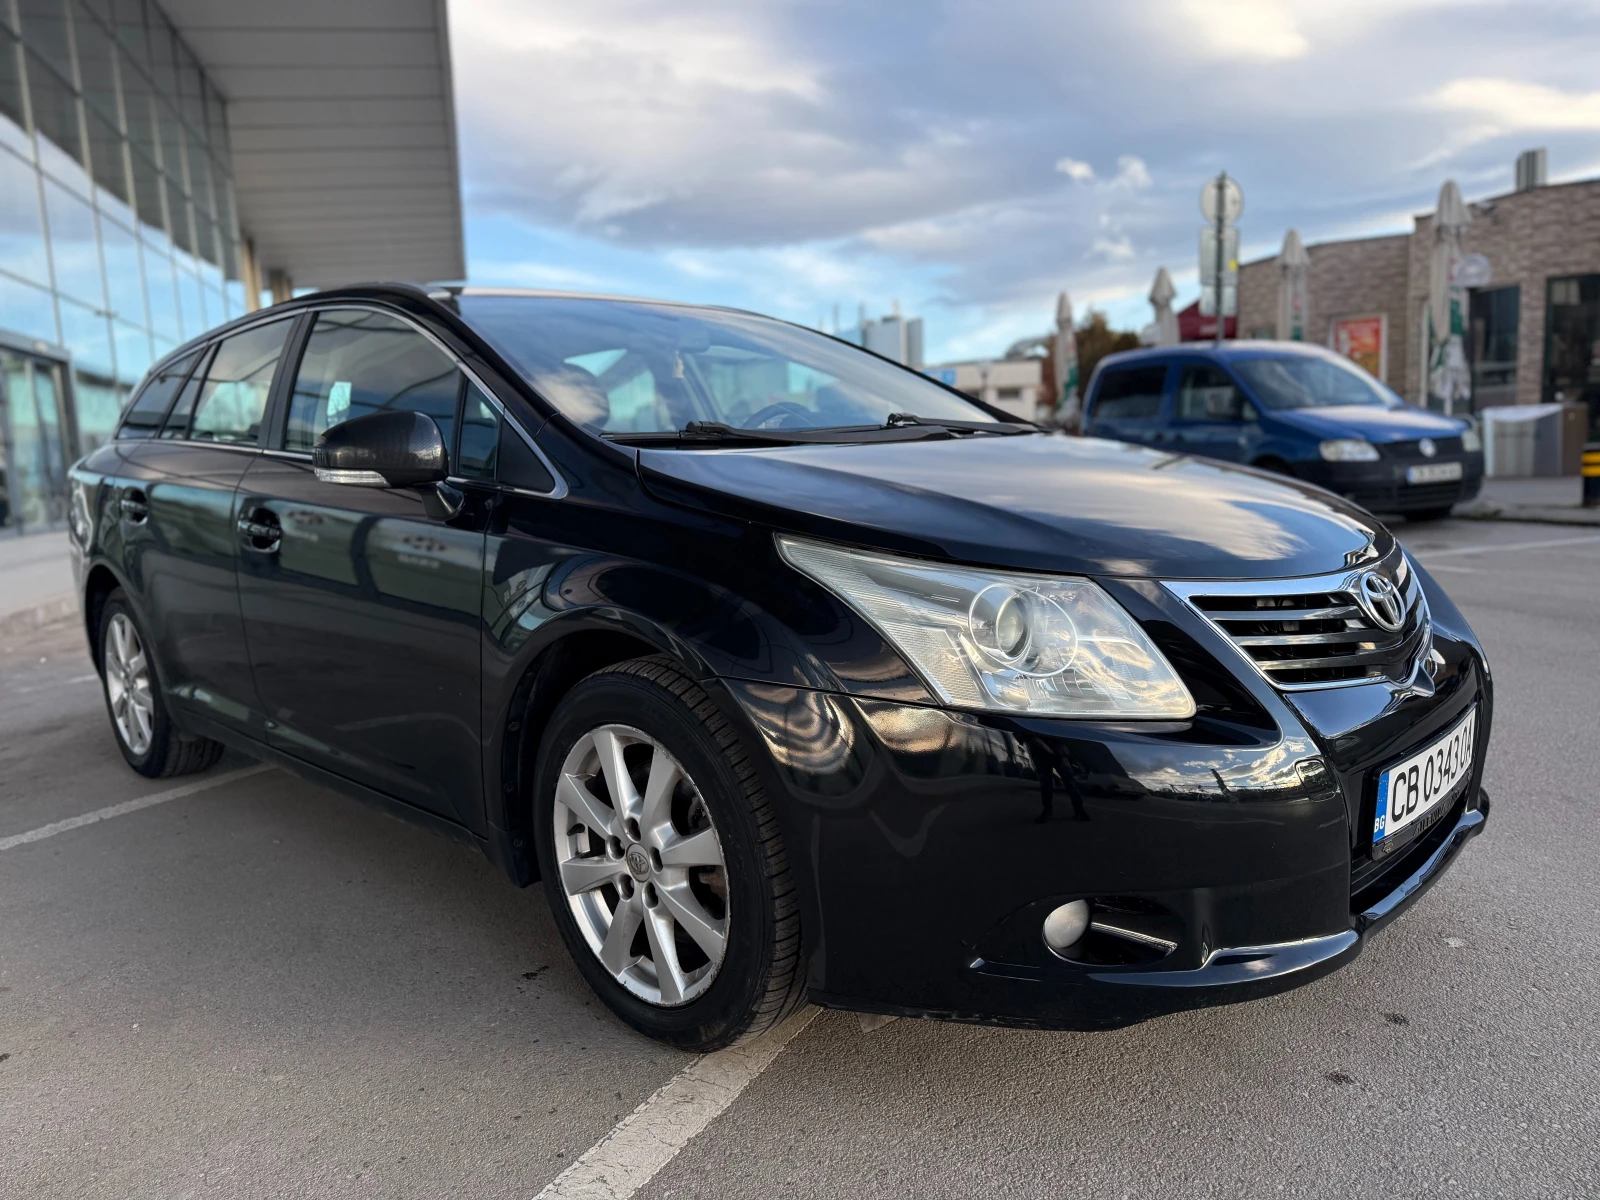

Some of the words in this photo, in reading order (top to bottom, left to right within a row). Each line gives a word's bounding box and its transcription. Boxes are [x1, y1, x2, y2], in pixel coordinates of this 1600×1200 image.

[1391, 764, 1420, 823] CB
[1424, 734, 1460, 802] 0343
[1374, 814, 1386, 834] BG
